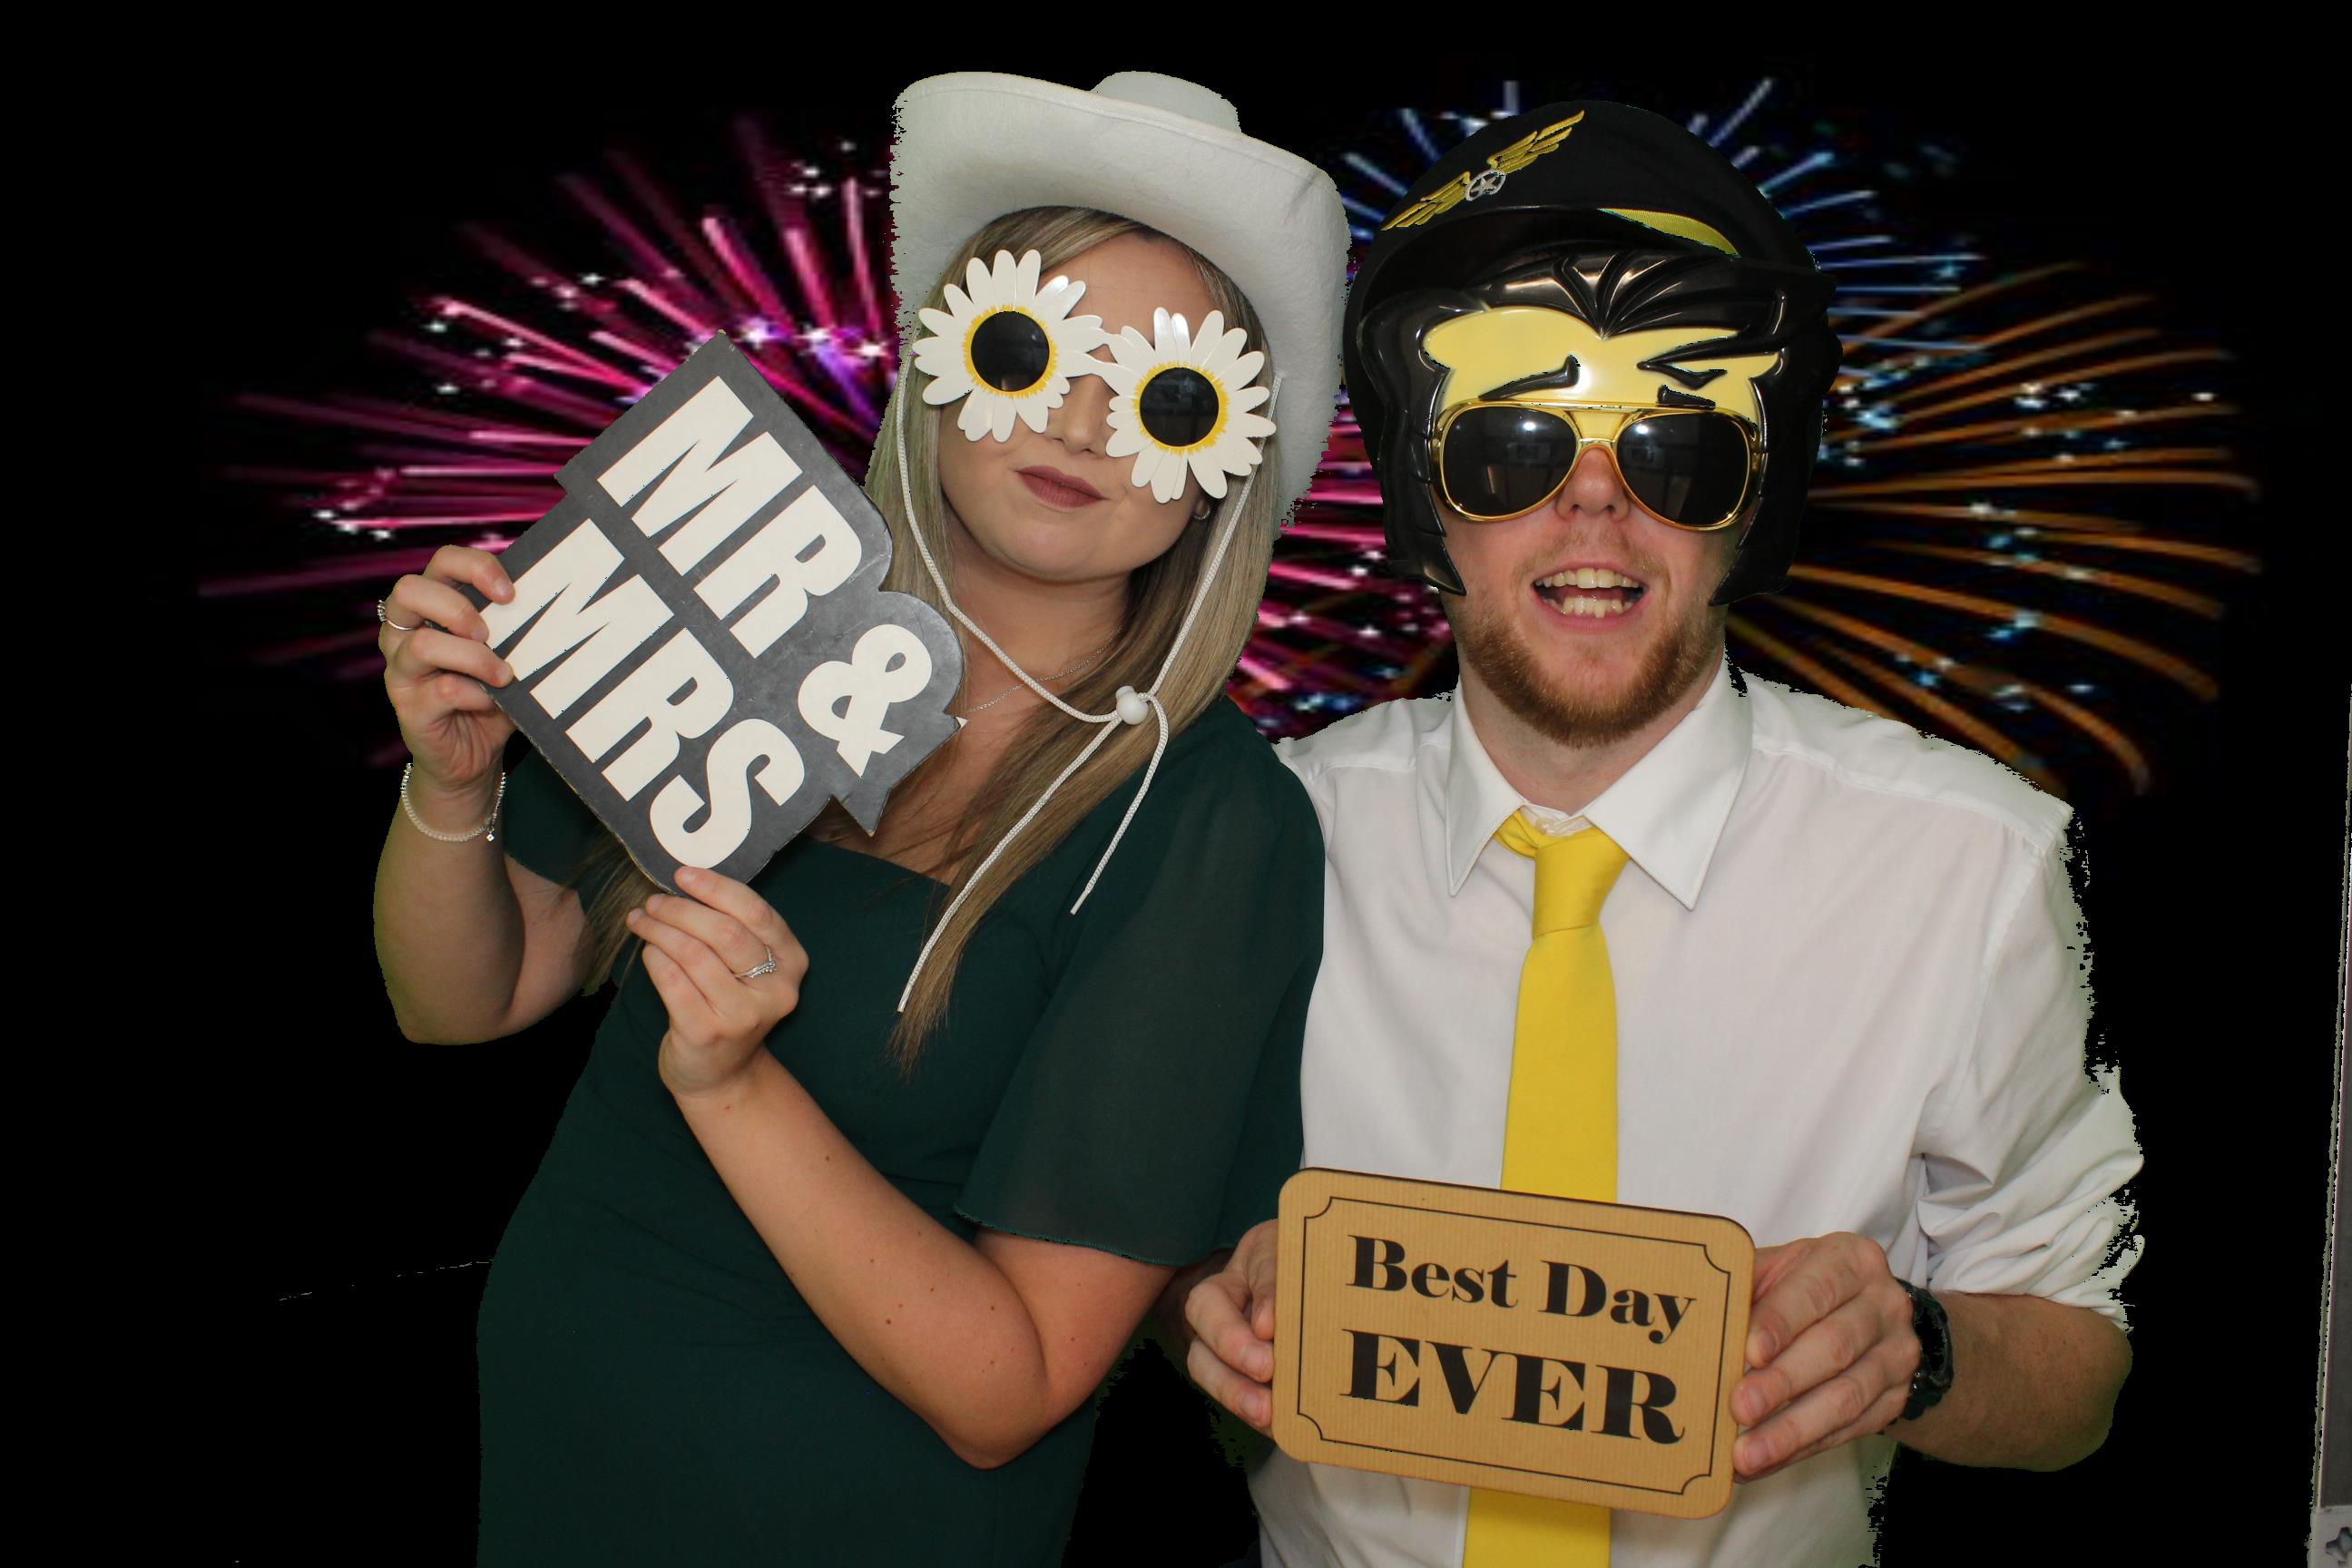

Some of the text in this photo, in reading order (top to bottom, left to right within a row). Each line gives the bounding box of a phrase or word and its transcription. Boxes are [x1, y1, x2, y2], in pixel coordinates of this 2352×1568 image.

[479, 518, 806, 870] MRS
[597, 376, 933, 778] MR &
[1339, 1328, 1686, 1445] EVER
[1345, 1234, 1697, 1344] Best Day
